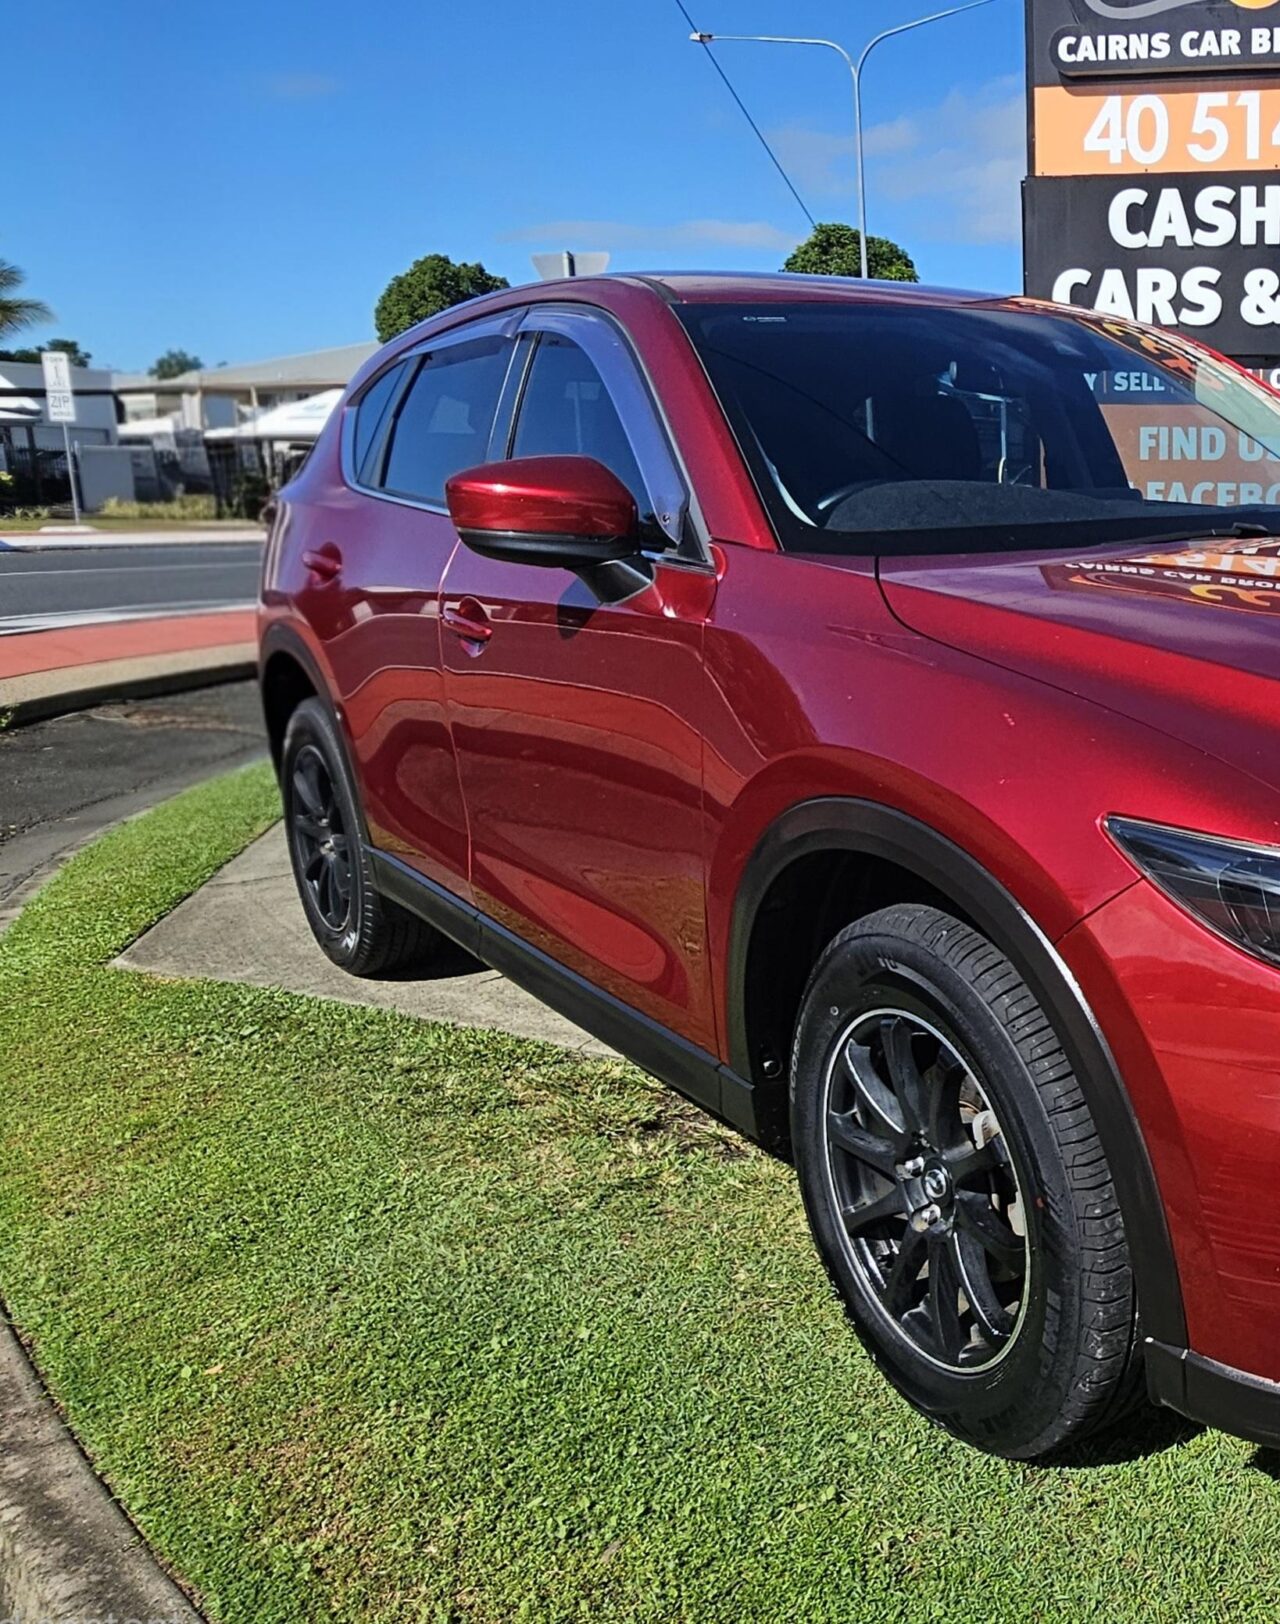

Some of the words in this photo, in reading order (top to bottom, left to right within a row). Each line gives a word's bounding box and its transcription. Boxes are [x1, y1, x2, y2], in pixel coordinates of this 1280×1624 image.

[1057, 32, 1171, 63] CAIRNS
[1180, 28, 1242, 58] CAR
[1083, 94, 1169, 165] 40
[1052, 265, 1223, 327] CARS
[1114, 372, 1165, 391] SELL
[50, 395, 70, 409] ZIP
[1139, 426, 1227, 461] FIND
